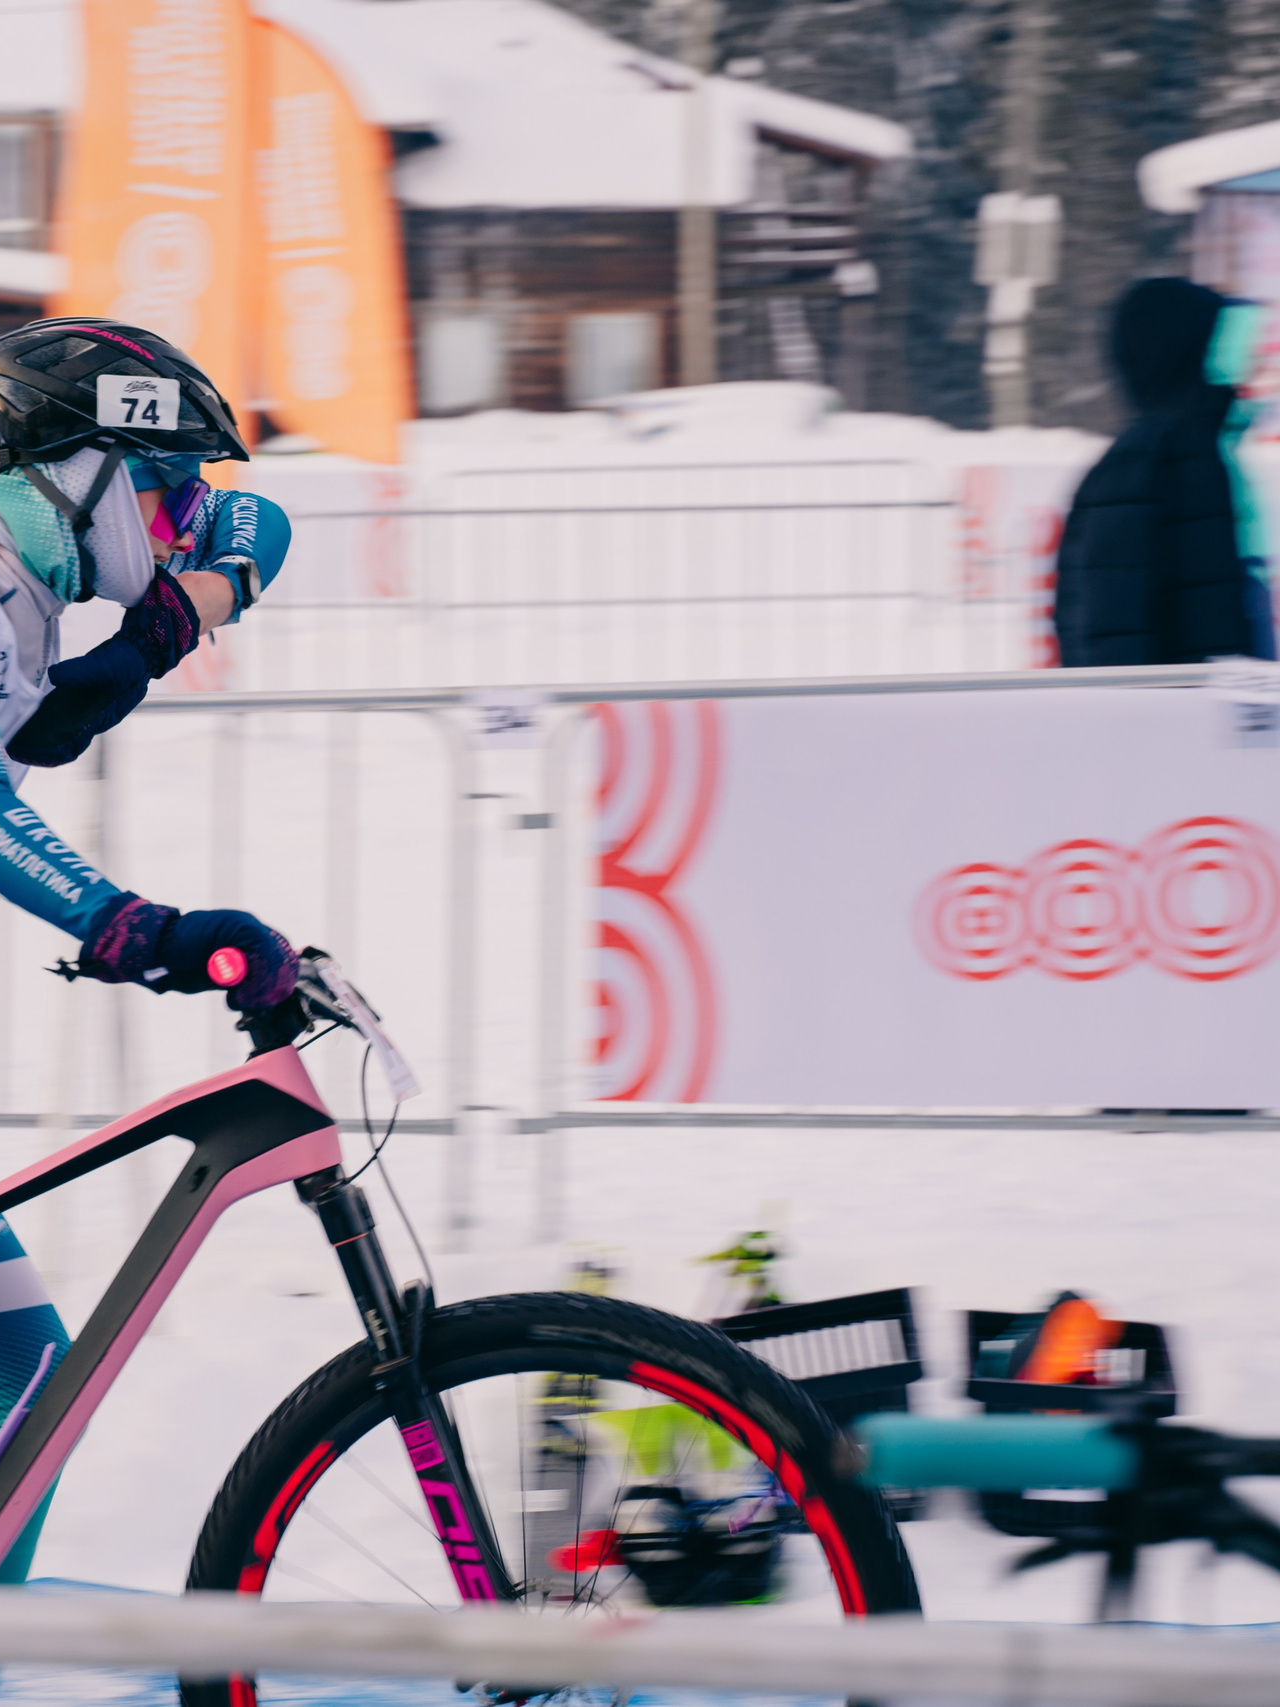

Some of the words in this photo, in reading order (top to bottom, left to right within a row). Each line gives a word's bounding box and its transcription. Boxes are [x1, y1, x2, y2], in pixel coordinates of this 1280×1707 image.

[96, 331, 145, 355] ALPINA
[121, 398, 160, 425] 74
[231, 497, 259, 552] ТРИАТЛОН
